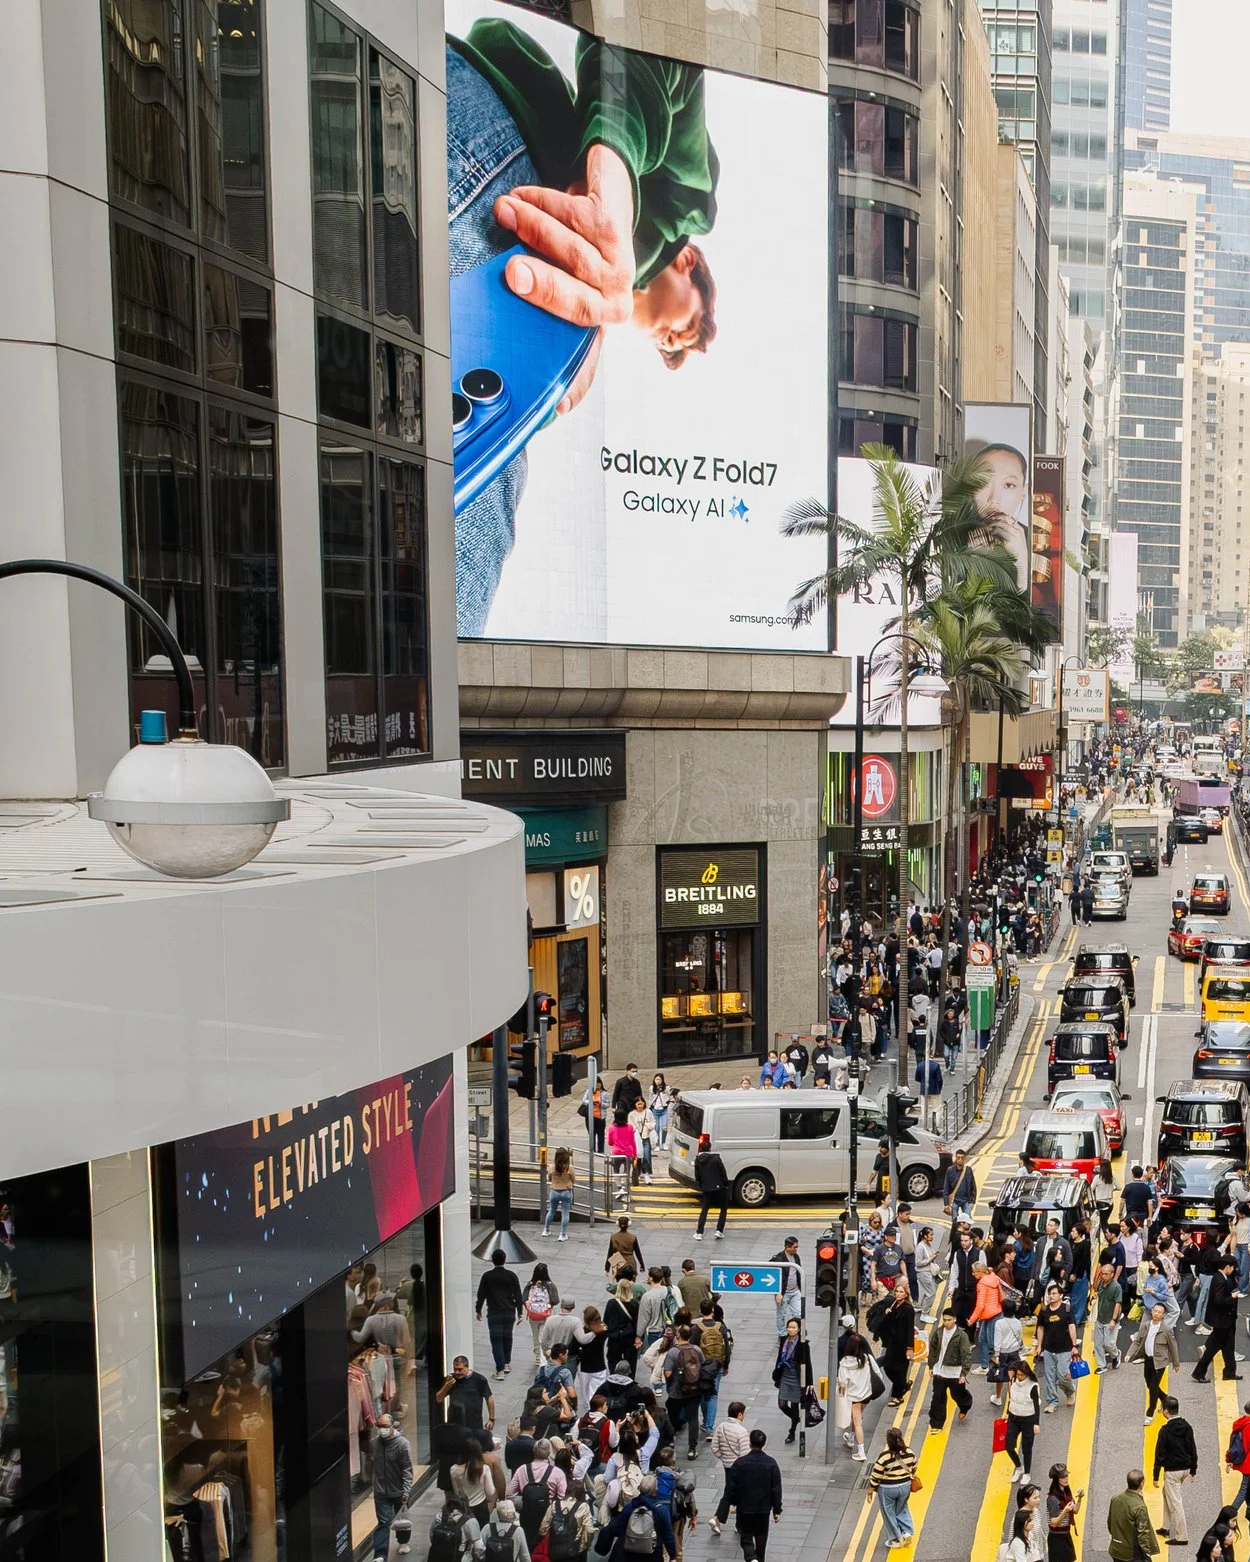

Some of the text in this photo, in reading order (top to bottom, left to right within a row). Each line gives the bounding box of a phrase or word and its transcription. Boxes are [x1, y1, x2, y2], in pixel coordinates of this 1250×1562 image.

[600, 446, 778, 486] Galaxy Z Fold7
[1036, 461, 1060, 470] FOOK
[622, 490, 725, 522] Galaxy AI
[533, 756, 612, 779] BUILDING
[1019, 763, 1047, 771] GUYS
[876, 842, 893, 850] SENG
[665, 884, 757, 902] BREITLING
[698, 903, 724, 915] 1884
[253, 1114, 355, 1218] ELEVATED
[362, 1082, 413, 1155] STYLE
